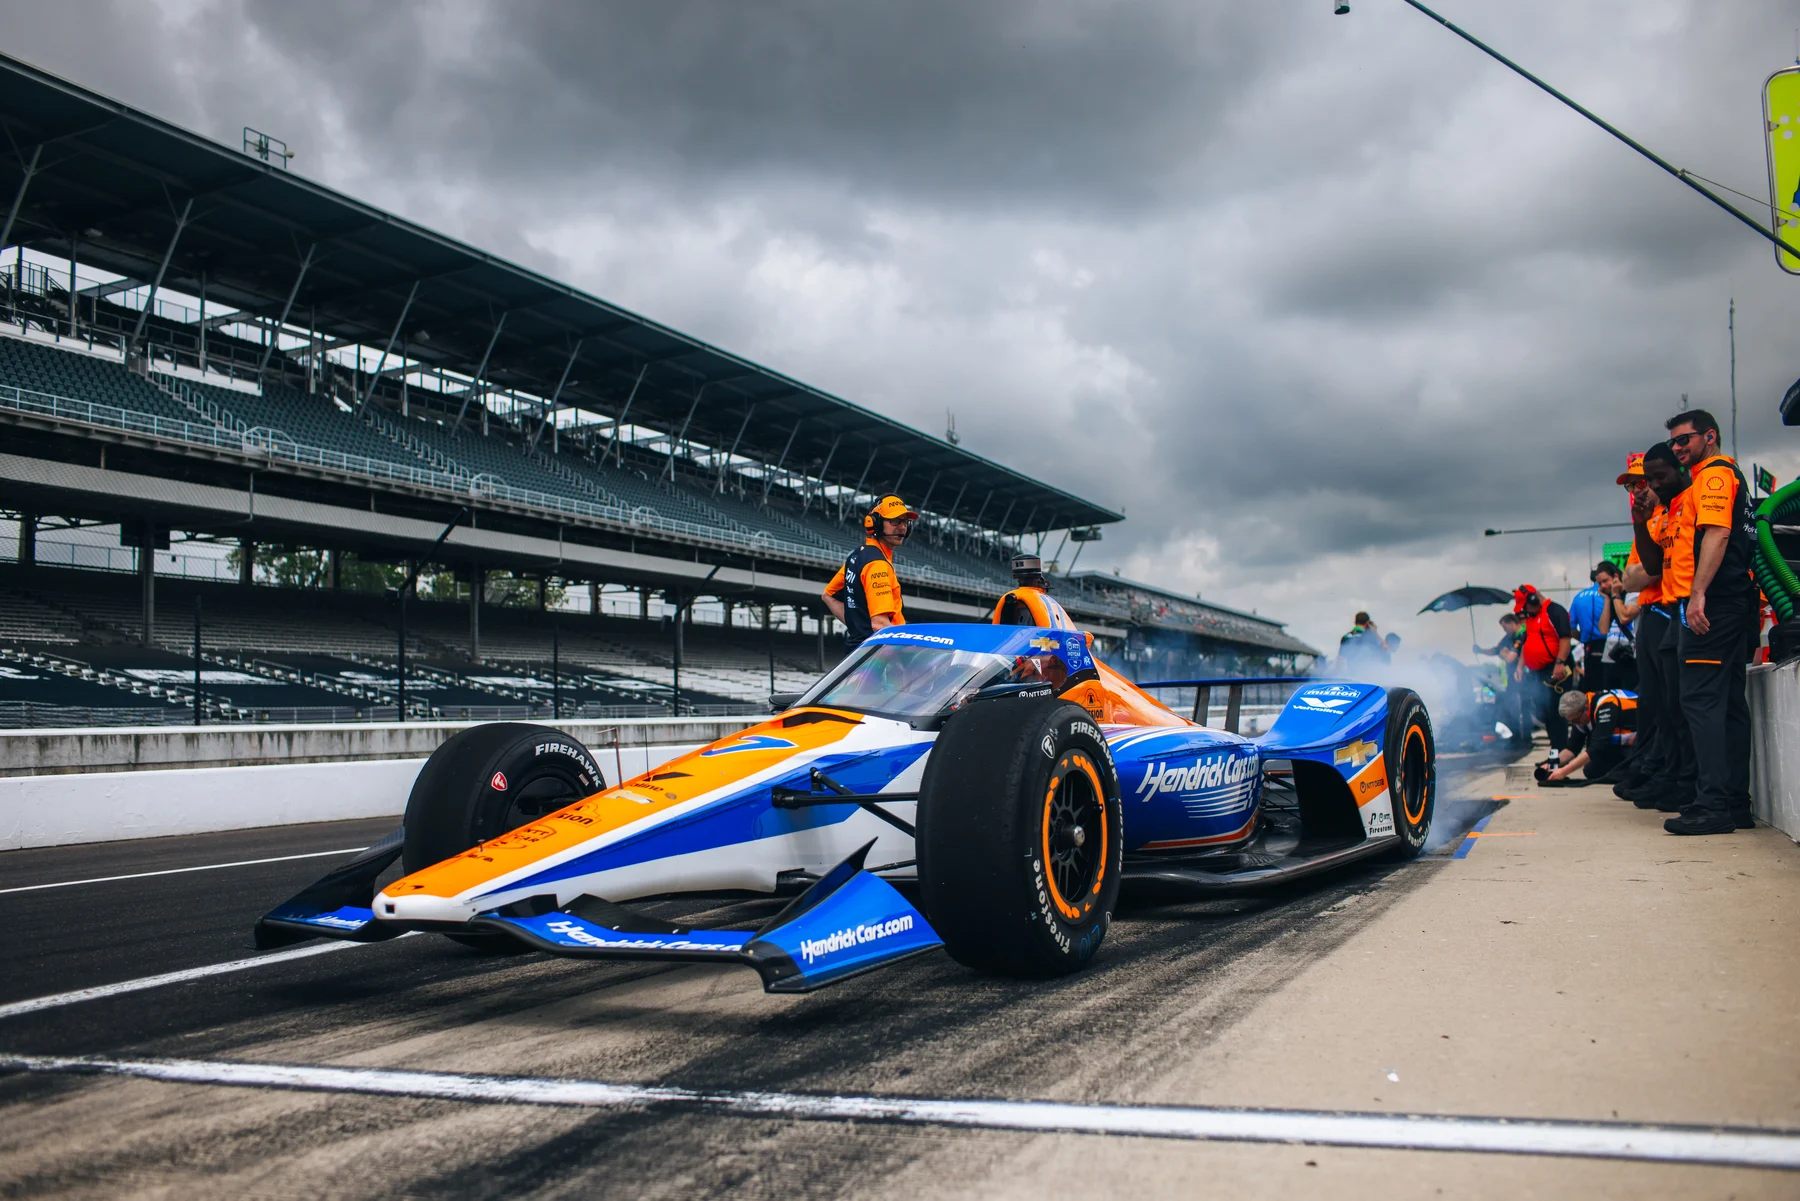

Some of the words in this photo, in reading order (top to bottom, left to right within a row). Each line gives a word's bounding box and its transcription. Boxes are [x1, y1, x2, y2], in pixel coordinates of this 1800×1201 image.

[1028, 690, 1040, 698] NTT
[535, 742, 602, 788] FIREHAWK
[1070, 721, 1118, 782] FIREHAWK
[1033, 859, 1070, 954] Firestone
